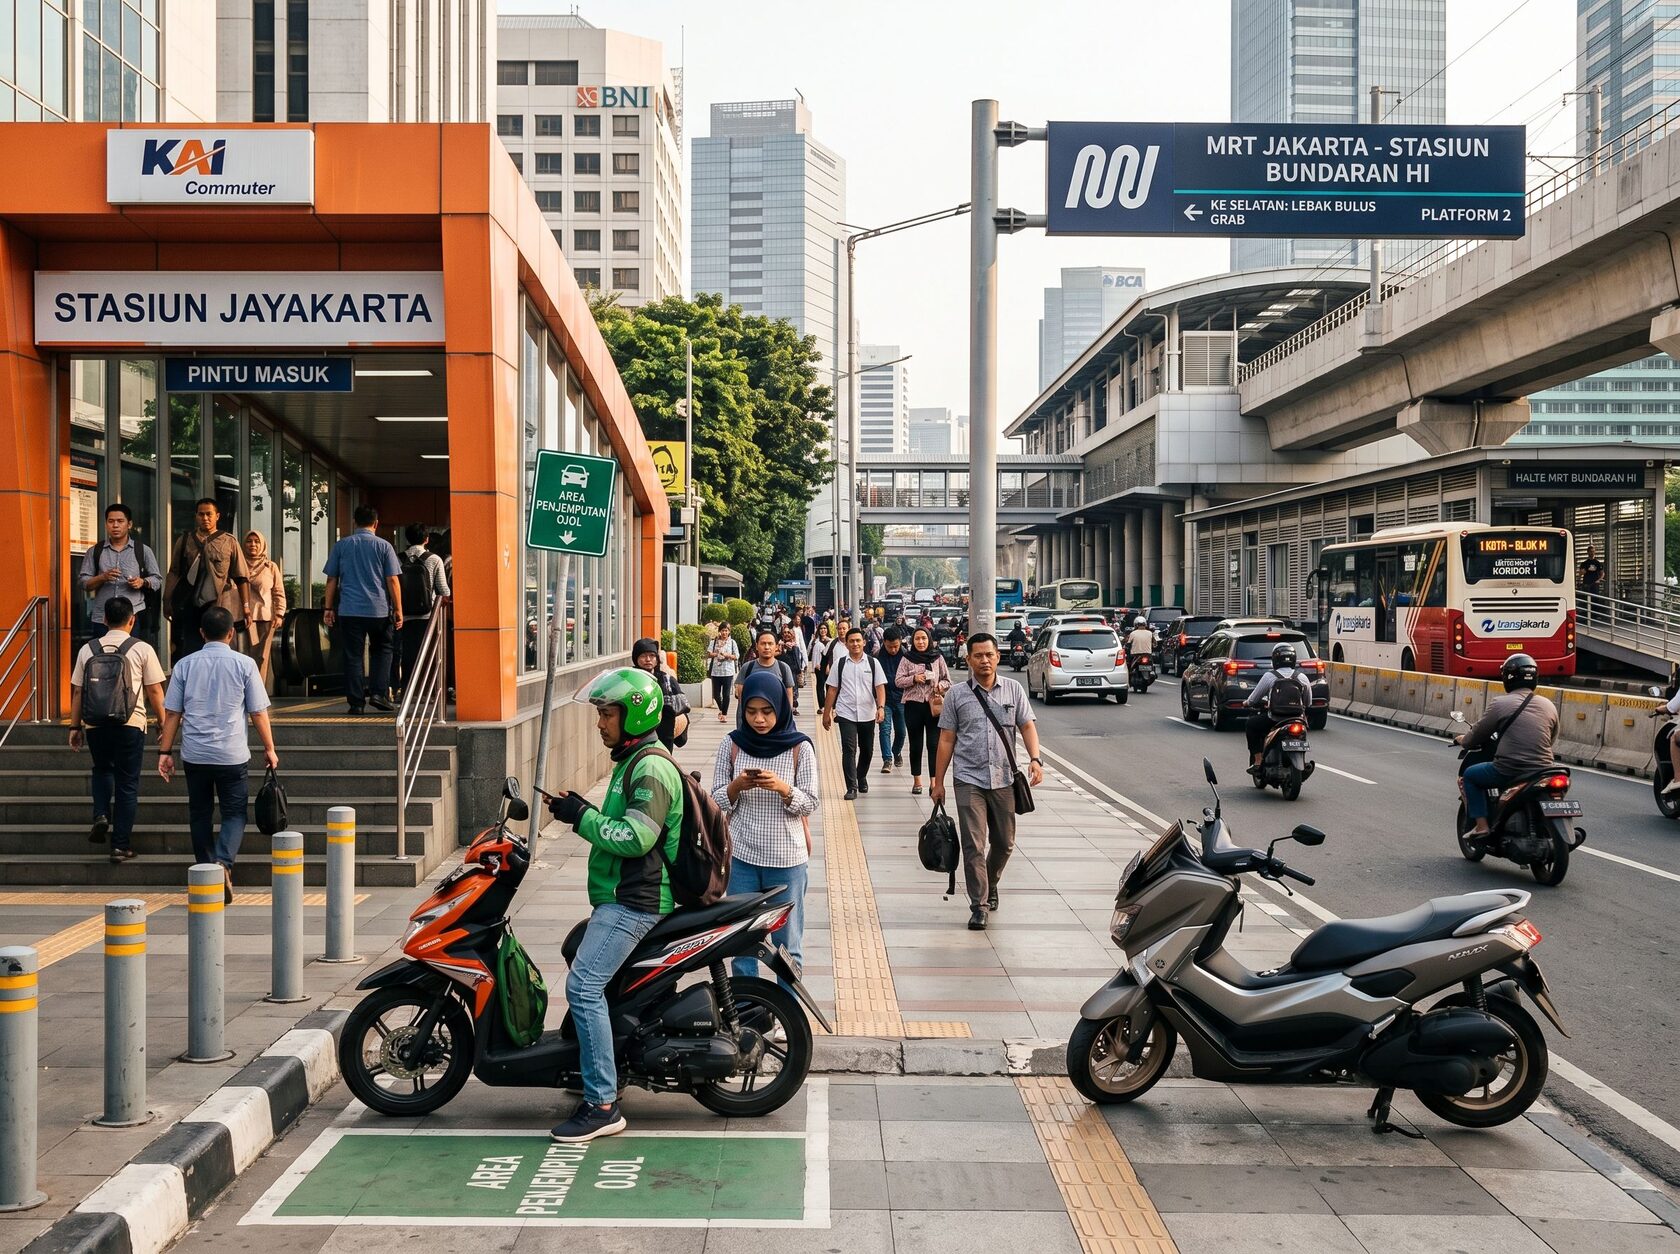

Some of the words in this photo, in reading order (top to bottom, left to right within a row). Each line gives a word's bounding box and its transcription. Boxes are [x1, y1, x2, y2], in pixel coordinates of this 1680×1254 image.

[602, 86, 648, 108] BNI
[1207, 136, 1257, 155] MRT
[1262, 136, 1369, 157] JAKARTA
[1389, 137, 1489, 157] STASIUN
[142, 139, 226, 175] KAI
[1266, 163, 1398, 183] BUNDARAN
[1406, 164, 1430, 183] HI
[185, 181, 276, 195] Commuter
[1210, 200, 1226, 211] KE
[1229, 200, 1288, 211] SELATAN:
[1291, 200, 1332, 211] LEBAK
[1334, 201, 1377, 212] BULUS
[1210, 214, 1245, 225] GRAB
[1421, 209, 1499, 221] PLATFORM
[1502, 209, 1511, 221] 2
[1115, 276, 1142, 288] BCA
[54, 293, 207, 323] STASIUN
[219, 293, 433, 323] JAYAKARTA
[188, 366, 249, 383] PINTU
[255, 366, 329, 383] MASUK
[1516, 473, 1546, 482] HALTE
[1548, 473, 1569, 482] MRT
[1571, 473, 1625, 482] BUNDARAN
[1627, 473, 1637, 482] HI
[559, 491, 585, 503] AREA
[536, 500, 606, 517] PENJEMPUTAN
[556, 516, 582, 527] OJOL
[1480, 541, 1484, 551] 1
[1516, 541, 1537, 551] BLOK
[1539, 541, 1547, 551] M
[1492, 567, 1531, 575] KORIDOR
[1533, 567, 1537, 575] 1
[1498, 619, 1550, 630] transjakarta
[466, 1155, 523, 1189] AREA
[594, 1156, 644, 1189] OJOL
